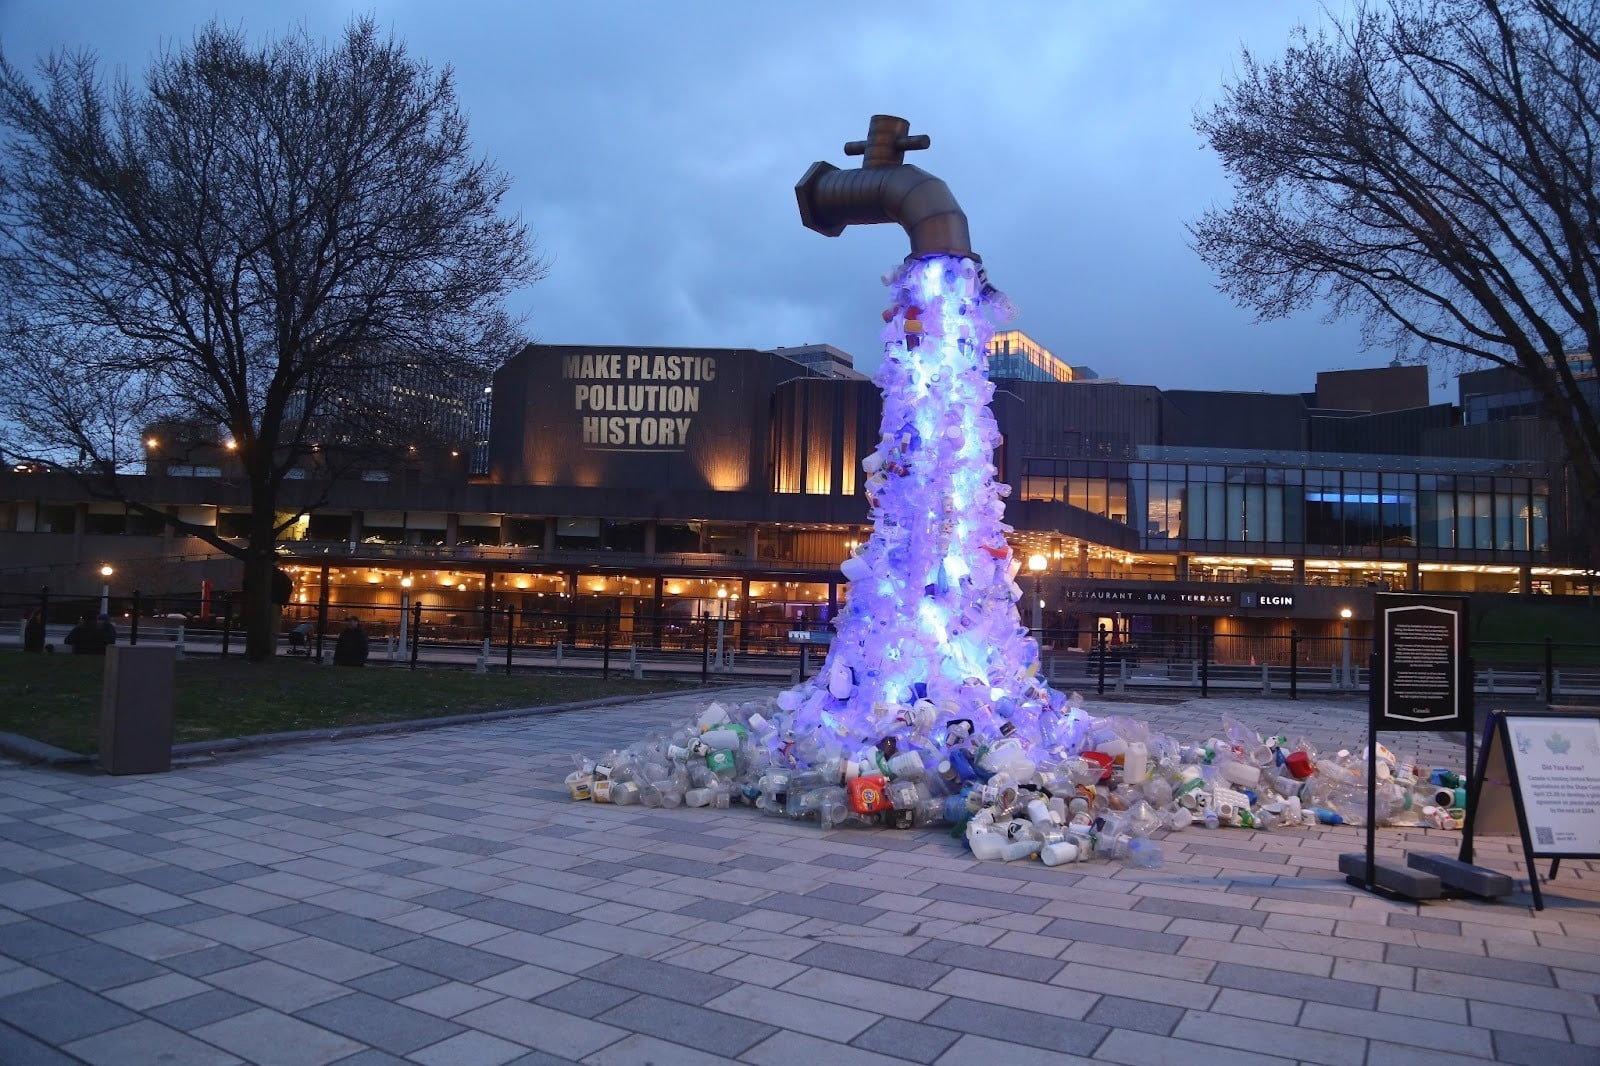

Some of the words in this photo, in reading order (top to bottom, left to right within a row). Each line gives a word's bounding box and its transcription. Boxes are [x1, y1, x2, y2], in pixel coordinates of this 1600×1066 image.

[562, 354, 622, 379] MAKE
[626, 355, 716, 382] PLASTIC
[575, 384, 700, 413] POLLUTION
[582, 416, 692, 446] HISTORY
[1147, 593, 1167, 601] BAR
[1180, 594, 1232, 603] TERRASSE
[1260, 596, 1293, 605] ELGIN
